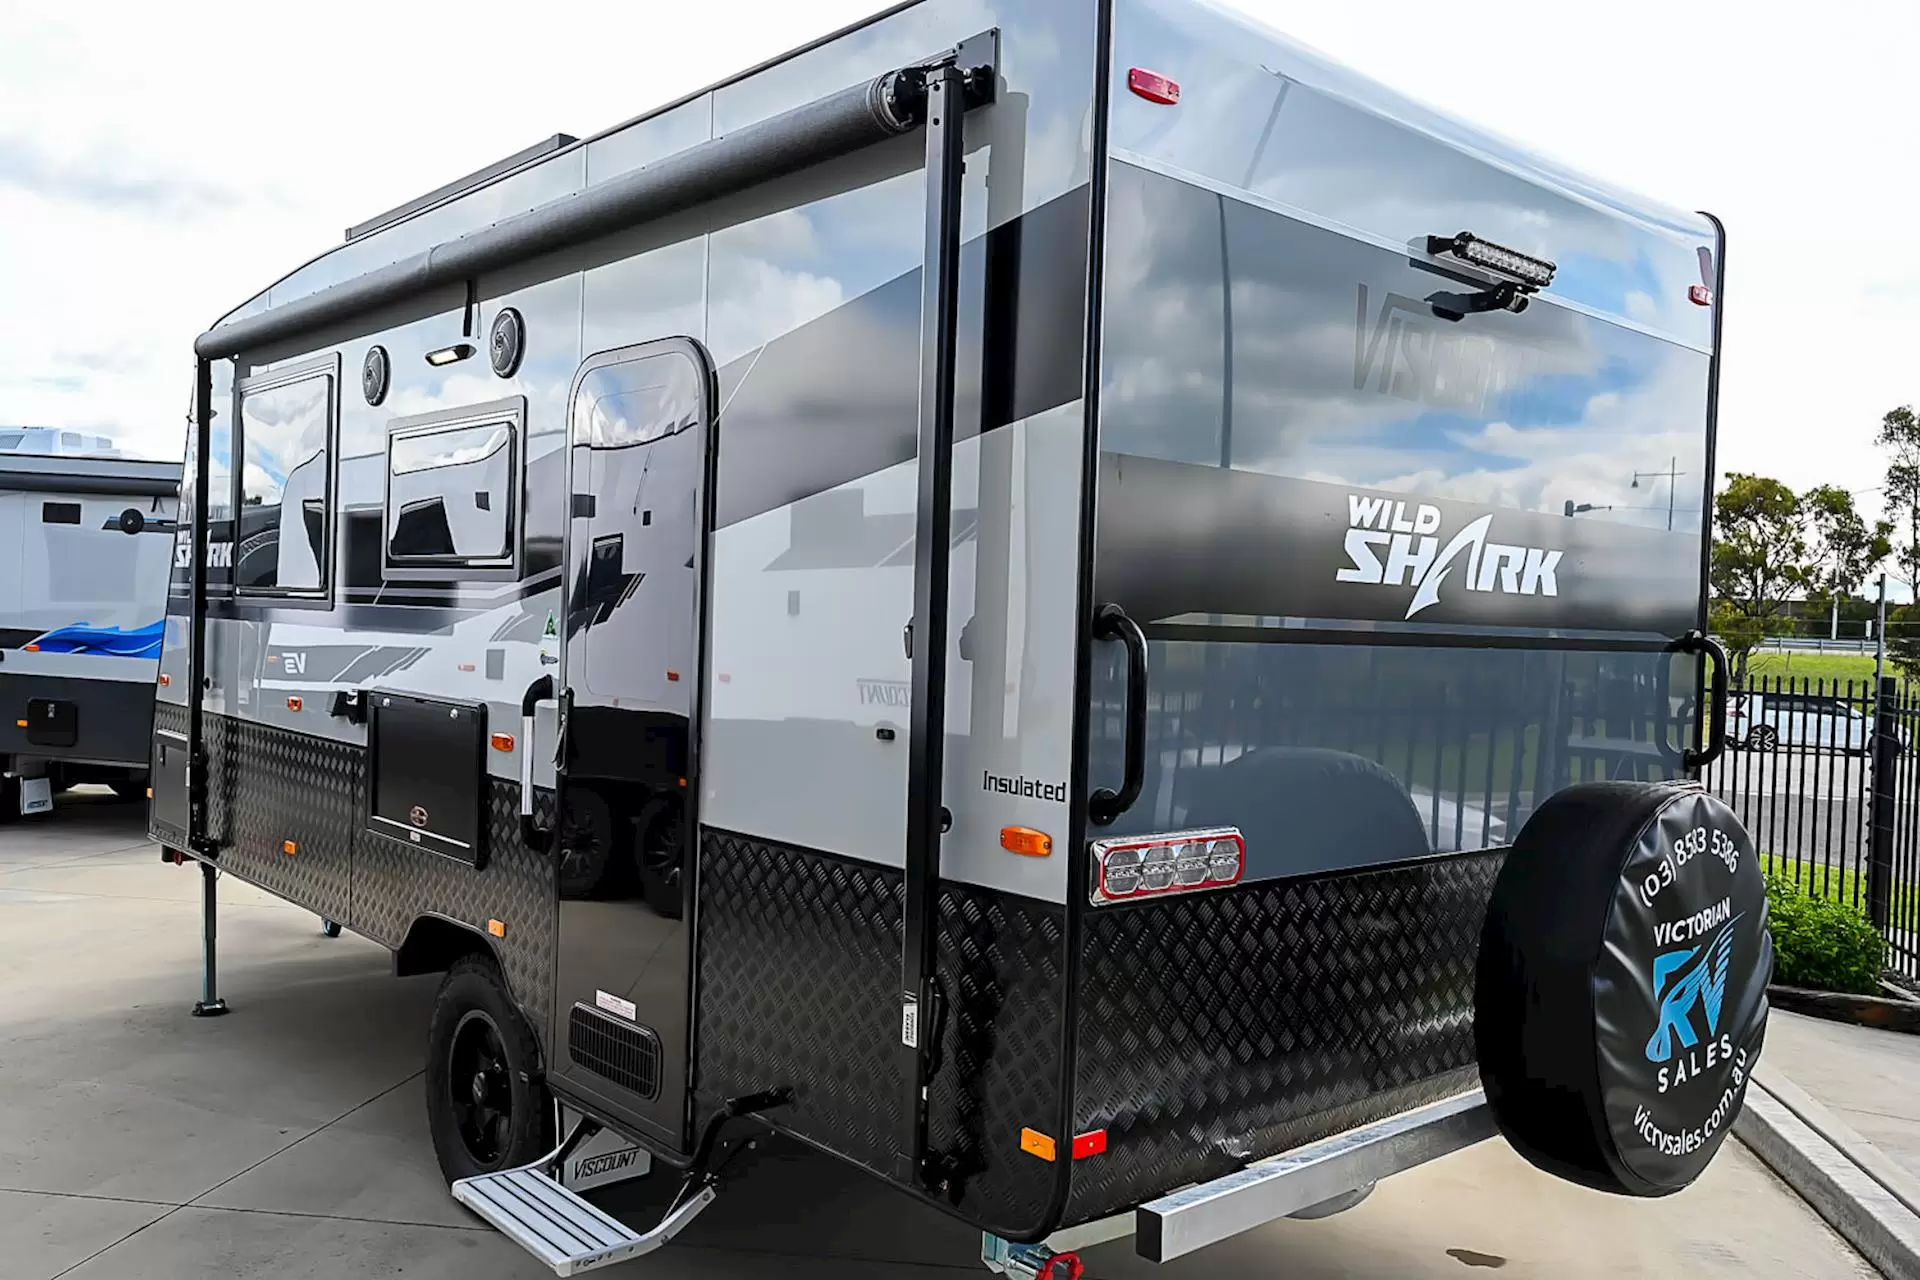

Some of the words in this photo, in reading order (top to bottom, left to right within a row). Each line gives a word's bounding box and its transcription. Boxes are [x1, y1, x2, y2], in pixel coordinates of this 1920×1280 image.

[1348, 494, 1441, 535] WILD
[1335, 513, 1564, 621] SHARK
[281, 651, 307, 674] EV
[983, 770, 1067, 803] Insulated
[1640, 853, 1677, 908] (03)
[1710, 828, 1740, 874] 5386
[1653, 896, 1731, 948] VICTORIAN
[1656, 1033, 1733, 1094] SALES
[1632, 1047, 1748, 1156] vicrvsales.com.au
[574, 1145, 641, 1181] VISCOUNT
